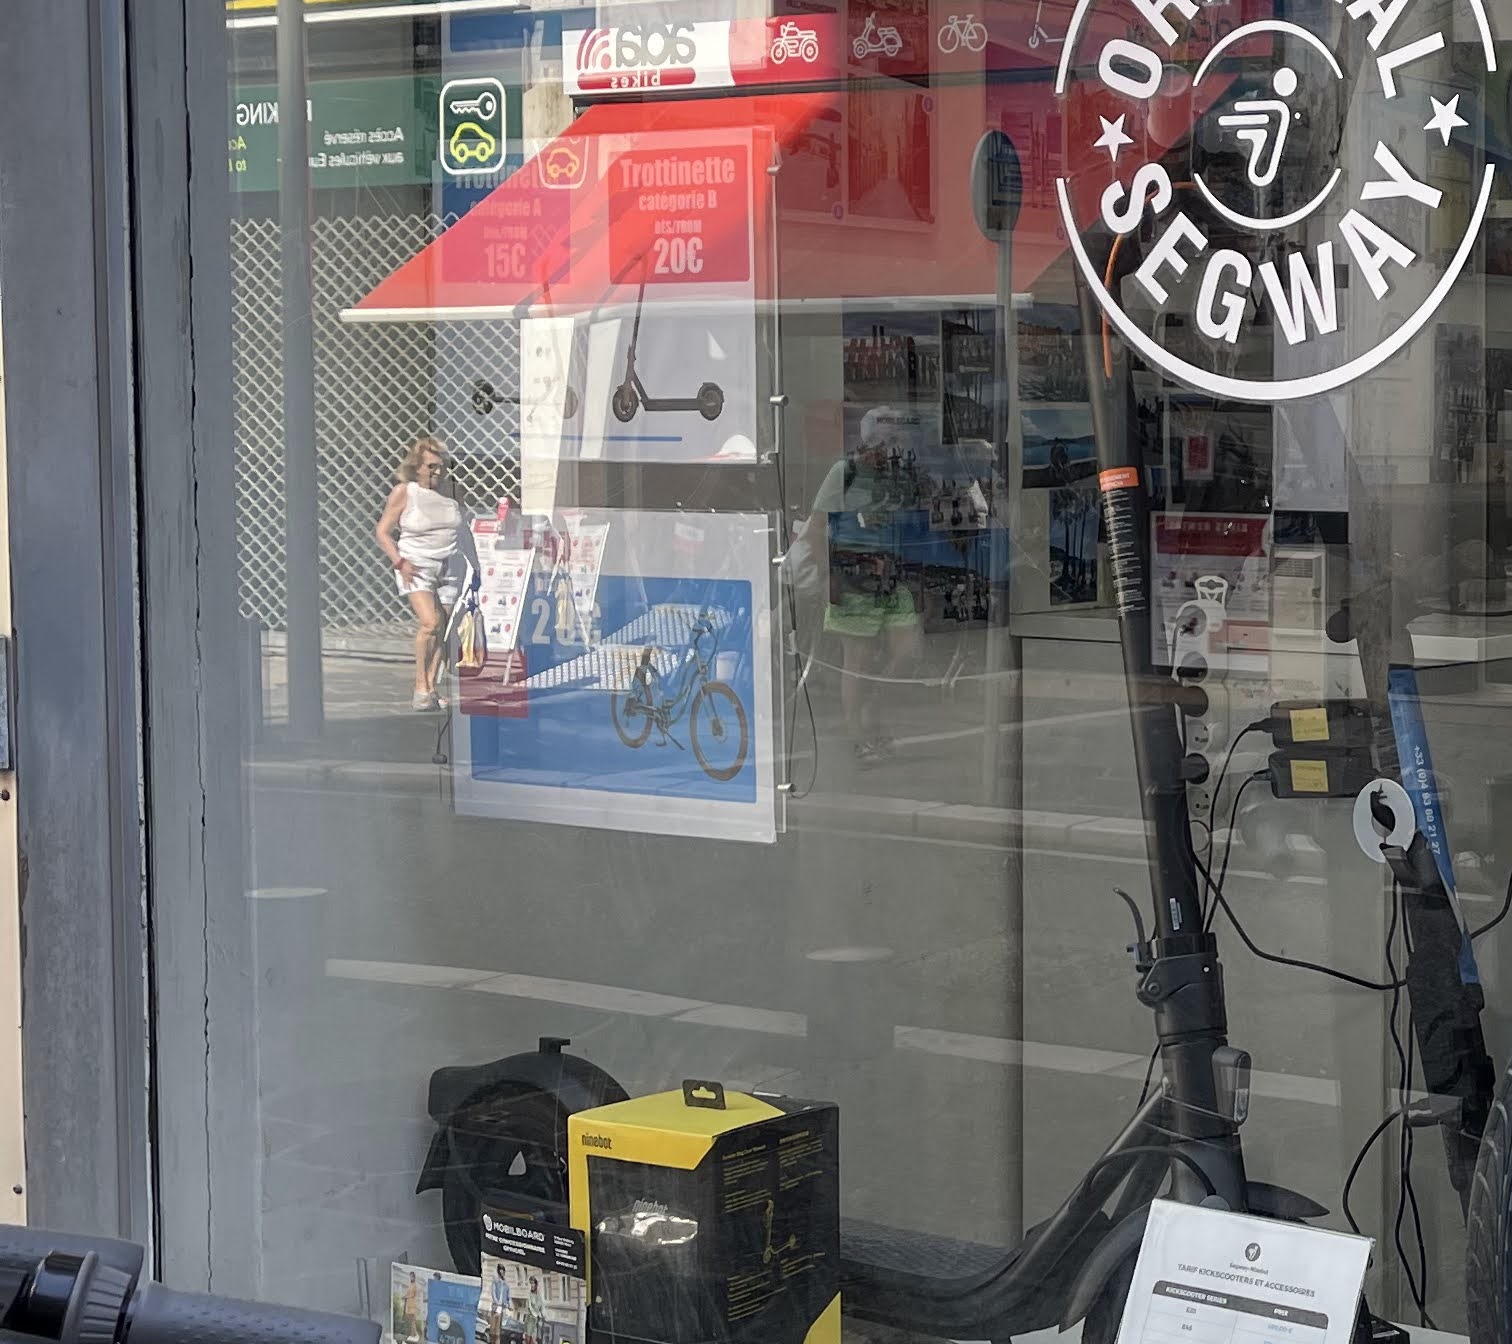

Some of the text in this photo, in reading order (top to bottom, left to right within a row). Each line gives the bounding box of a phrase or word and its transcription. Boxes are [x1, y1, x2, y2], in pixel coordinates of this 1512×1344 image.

[621, 156, 736, 189] Trottinette
[638, 189, 718, 213] catégorie B
[653, 237, 705, 275] 20€
[1099, 141, 1443, 346] SEGWAY
[484, 243, 527, 280] 15€
[1428, 825, 1438, 839] 21
[1432, 840, 1441, 855] 27
[582, 1132, 612, 1150] ninebot
[632, 1198, 669, 1217] ninebot
[1178, 1264, 1316, 1298] TARIF KICKSCOOTERS ET ACCESSOIRES
